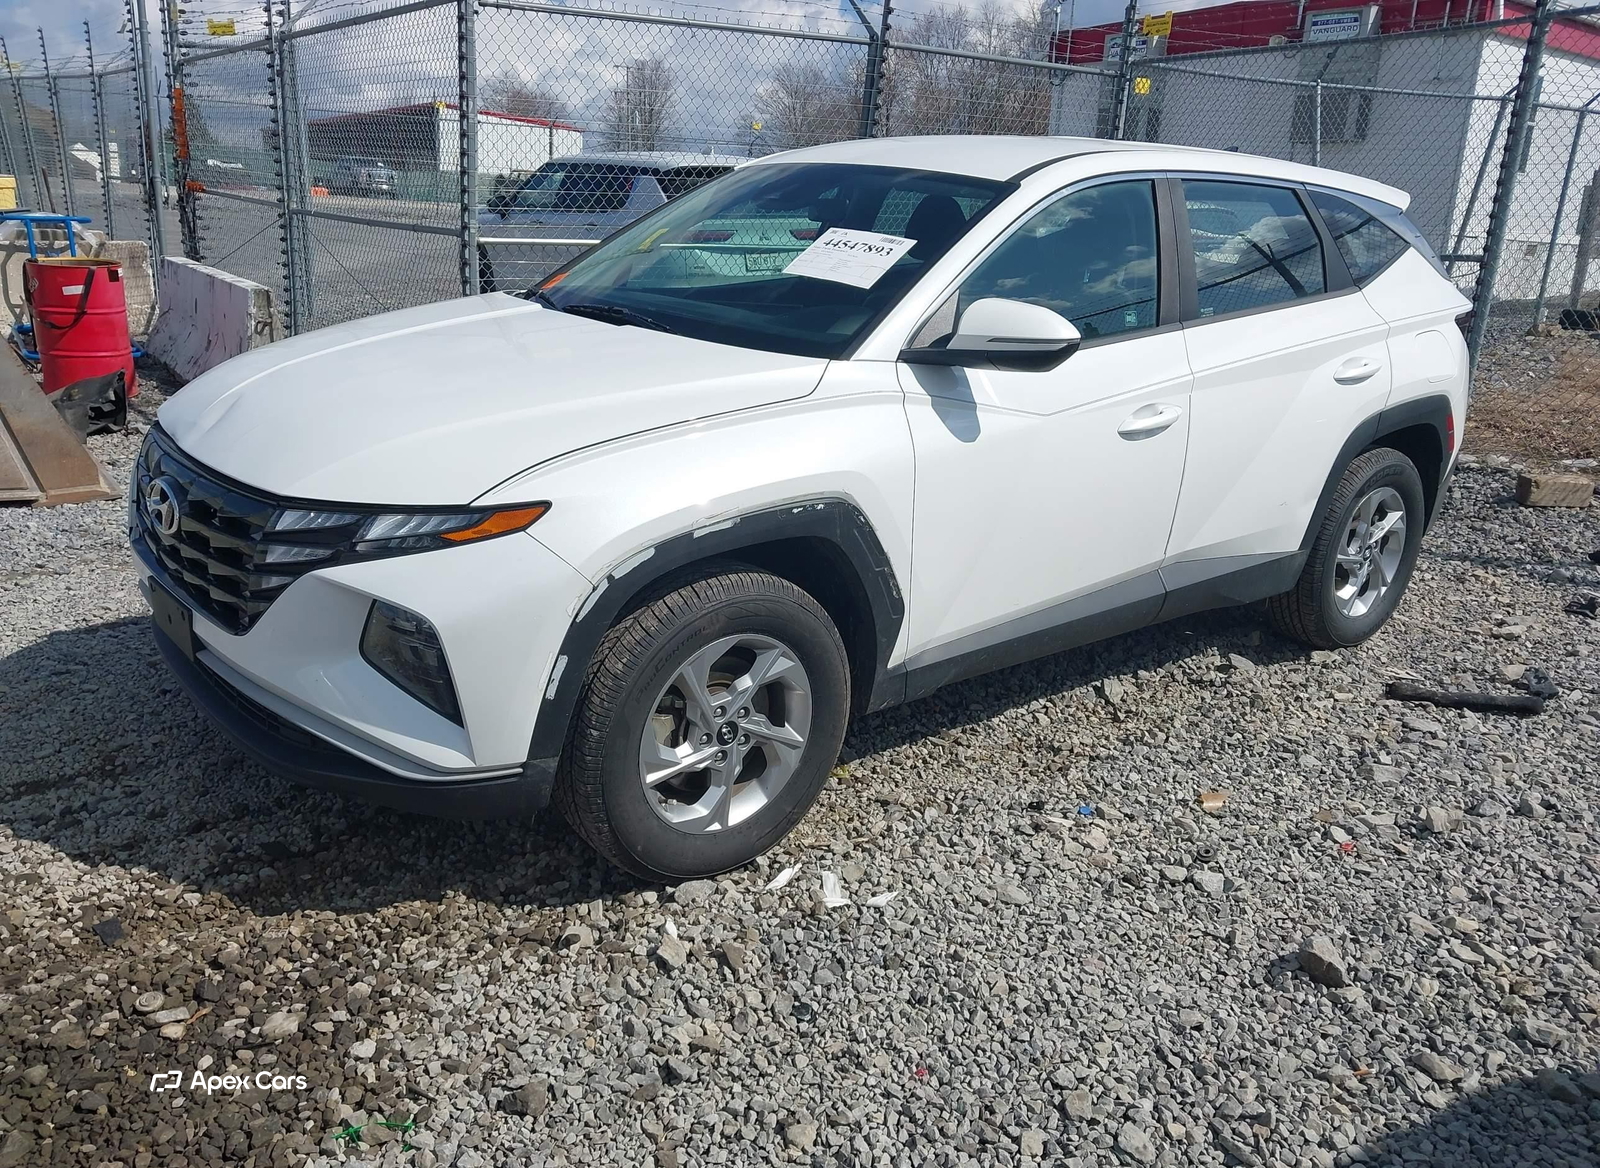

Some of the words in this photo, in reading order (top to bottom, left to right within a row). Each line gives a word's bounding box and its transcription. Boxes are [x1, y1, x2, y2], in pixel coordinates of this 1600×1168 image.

[1312, 25, 1358, 35] VANGUARD
[823, 237, 893, 257] 44547893
[1364, 466, 1402, 492] COOPER
